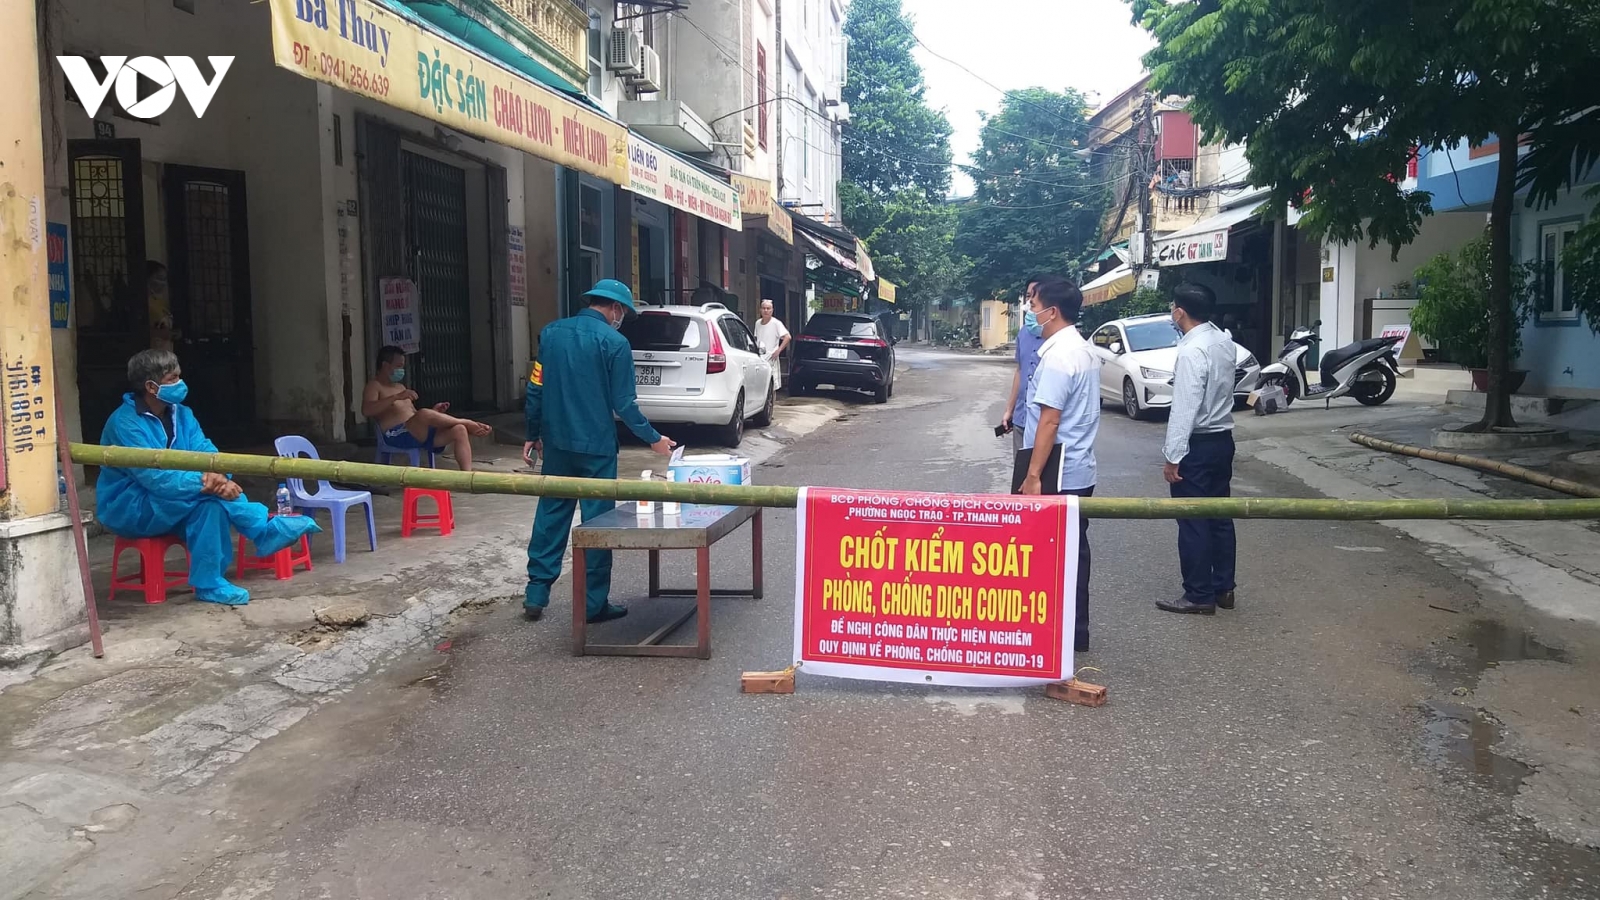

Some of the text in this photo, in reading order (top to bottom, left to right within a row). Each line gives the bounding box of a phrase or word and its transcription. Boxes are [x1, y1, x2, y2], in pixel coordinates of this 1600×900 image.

[335, 0, 391, 69] Thúy
[292, 42, 311, 68] ĐT
[320, 52, 390, 98] 0941.256.639
[417, 47, 451, 114] ĐẶC
[455, 61, 488, 122] SẢN
[493, 80, 524, 135] CHÁO
[563, 109, 586, 158] MIẾN
[98, 122, 112, 137] 94
[645, 151, 658, 172] BÉO
[640, 366, 655, 376] 36A
[34, 410, 44, 420] B
[831, 494, 1042, 512] BCĐ PHÒNG, CHỐNG DỊCH COVID-19
[849, 505, 887, 518] PHƯỜNG
[890, 509, 917, 522] NGỌC
[919, 510, 943, 522] TRẠO
[952, 512, 999, 524] TP.THANH
[1001, 511, 1022, 524] HÓA
[840, 525, 1034, 578] CHỐT KIỂM SOÁT
[823, 571, 1048, 626] PHÒNG, CHỐNG DỊCH COVID-19
[830, 615, 1032, 646] ĐỀ NGHỊ CÔNG DÂN THỰC HIỆN NGHIÊM
[819, 636, 1044, 669] QUY ĐỊNH VỀ PHÒNG, CHỐNG DỊCH COVID-19
